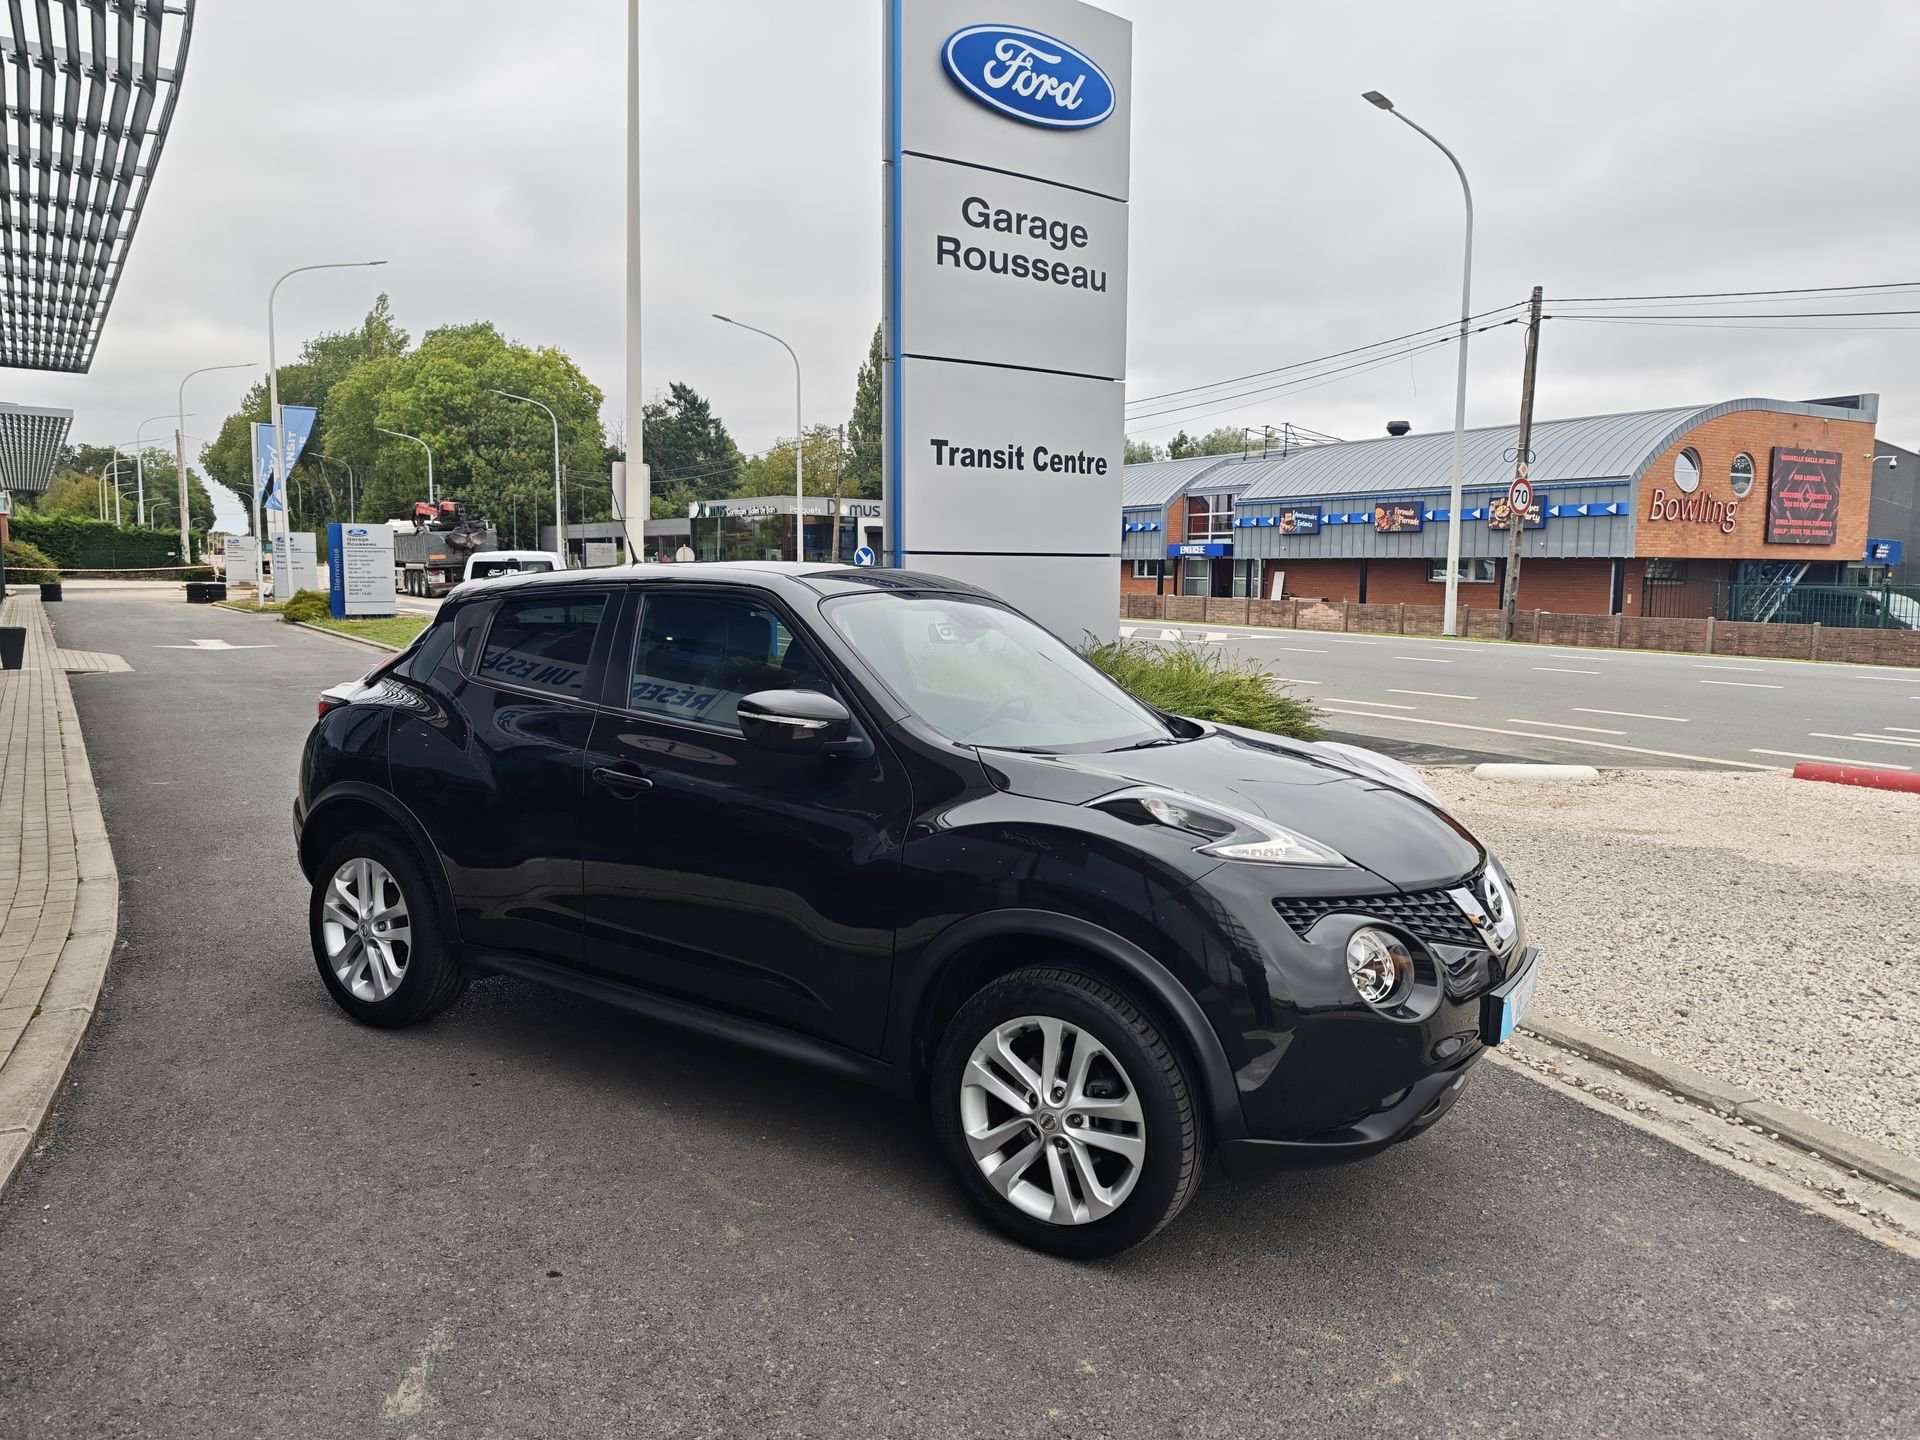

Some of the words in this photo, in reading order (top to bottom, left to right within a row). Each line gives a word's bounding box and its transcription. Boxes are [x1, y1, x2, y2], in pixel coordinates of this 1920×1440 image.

[983, 37, 1087, 112] Ford
[961, 196, 1089, 251] Garage
[935, 235, 1107, 293] Rousseau
[930, 438, 1024, 472] Transit
[1032, 446, 1108, 475] Centre
[1515, 490, 1528, 504] 70
[1649, 489, 1738, 534] Bowling
